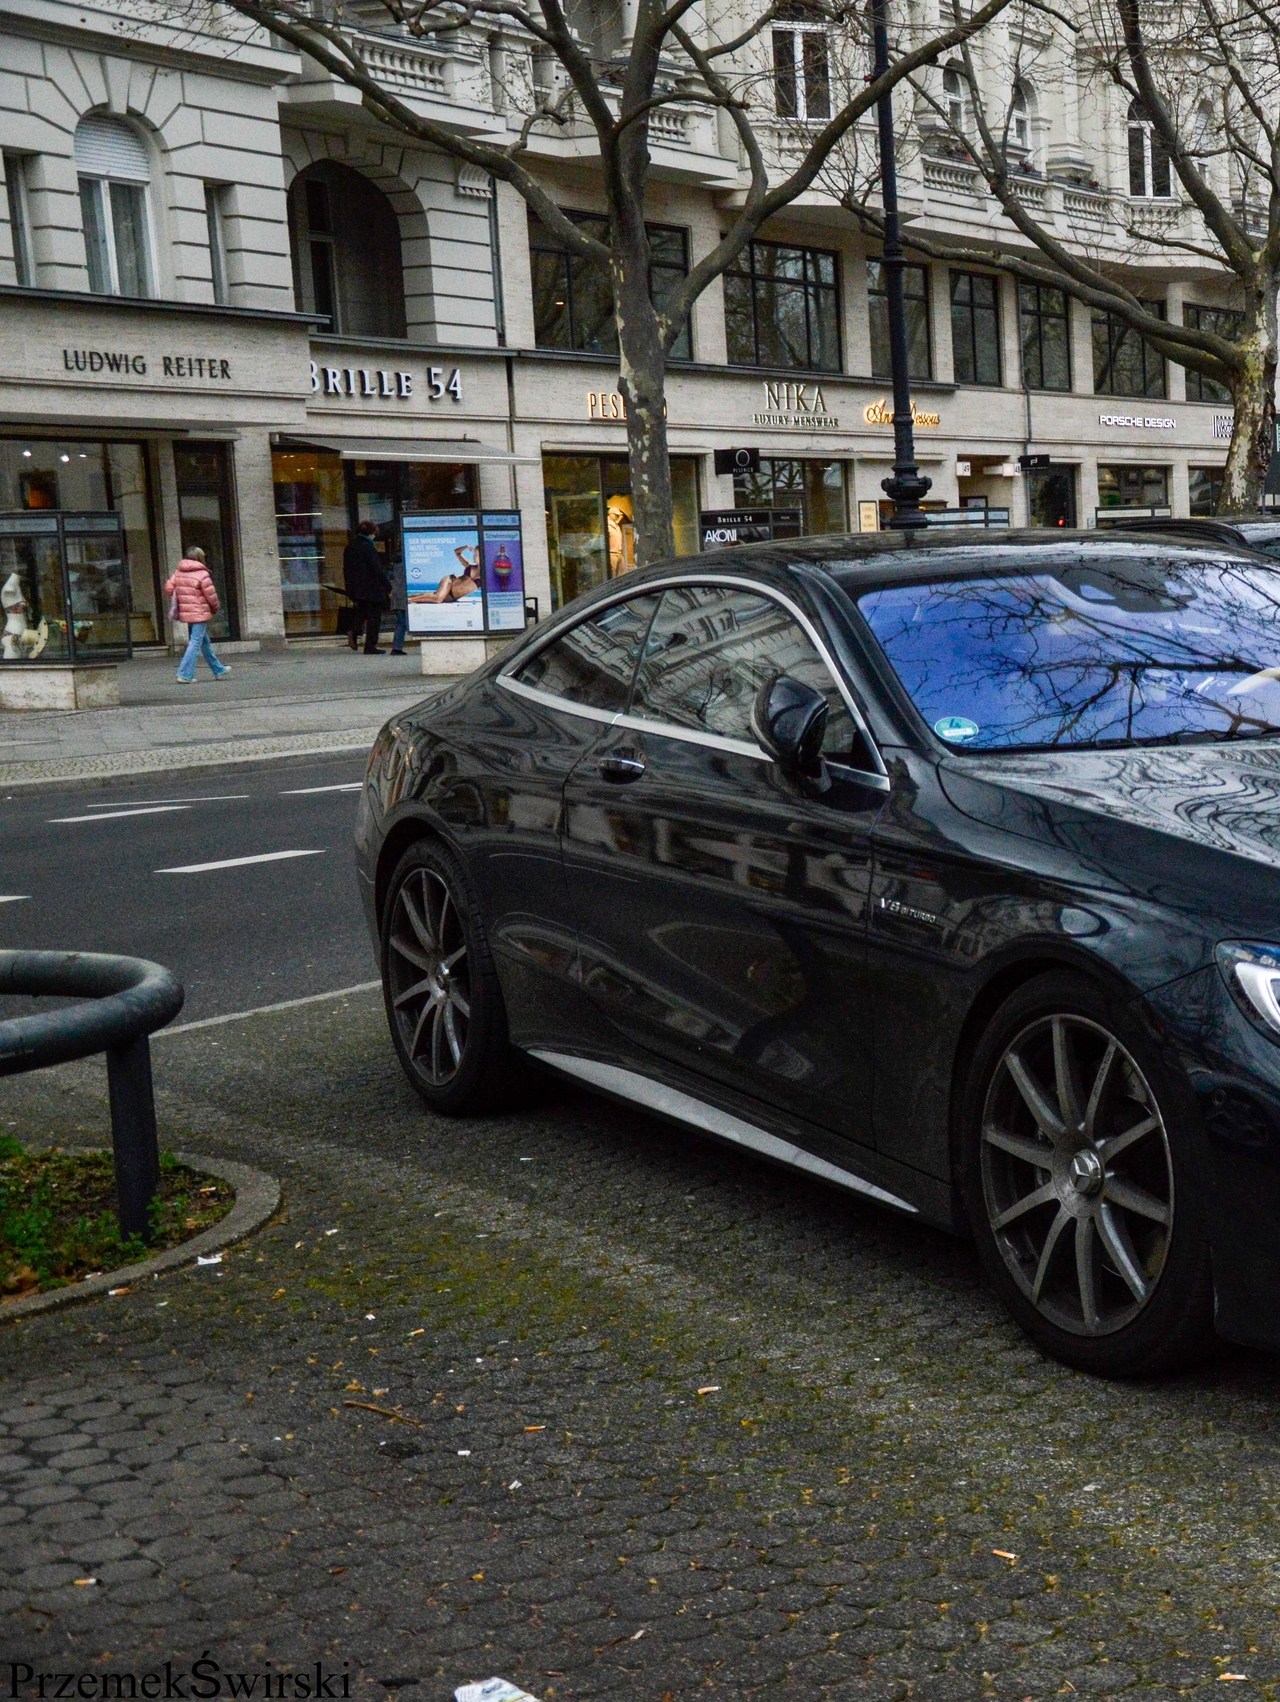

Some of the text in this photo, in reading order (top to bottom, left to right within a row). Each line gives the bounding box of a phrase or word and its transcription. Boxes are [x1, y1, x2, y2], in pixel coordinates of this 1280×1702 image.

[63, 350, 232, 379] LUDWIG REITER
[427, 366, 464, 399] 54
[763, 381, 827, 413] NIKA
[753, 413, 839, 428] LUXURY MENSWEAR
[1098, 414, 1177, 429] PORSCHE DESIGN
[705, 528, 738, 543] AKONI
[880, 897, 901, 913] V8
